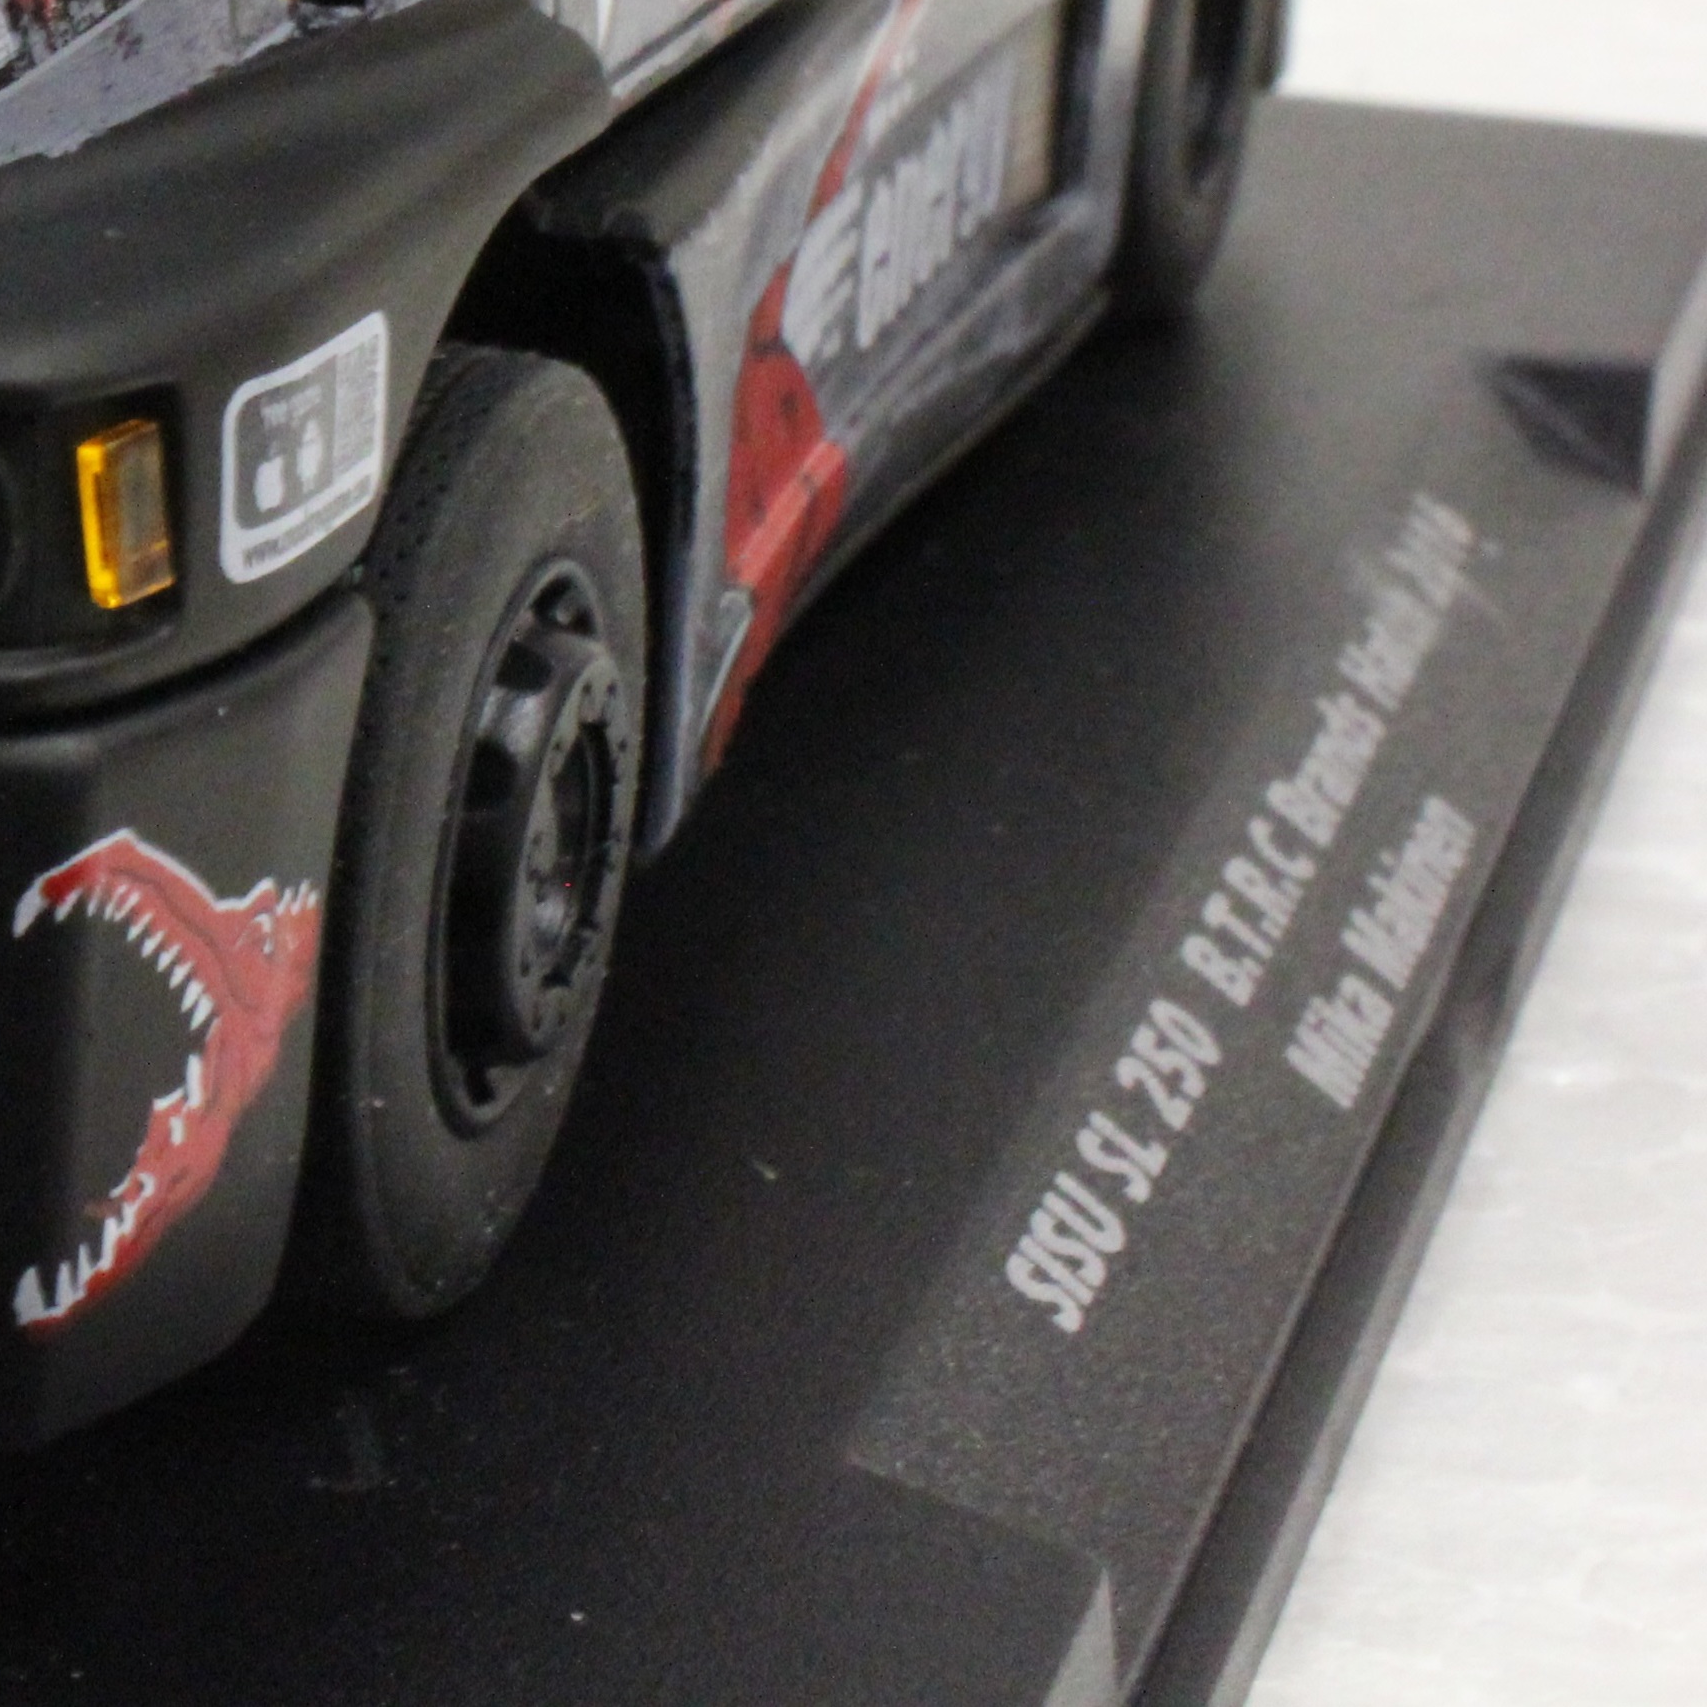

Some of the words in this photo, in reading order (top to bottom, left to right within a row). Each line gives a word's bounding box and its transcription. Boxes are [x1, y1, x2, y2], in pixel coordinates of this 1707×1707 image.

[1265, 692, 1387, 847] Brands
[1115, 996, 1223, 1132] 250
[1074, 1108, 1169, 1204] SL
[1004, 1168, 1127, 1334] SISU
